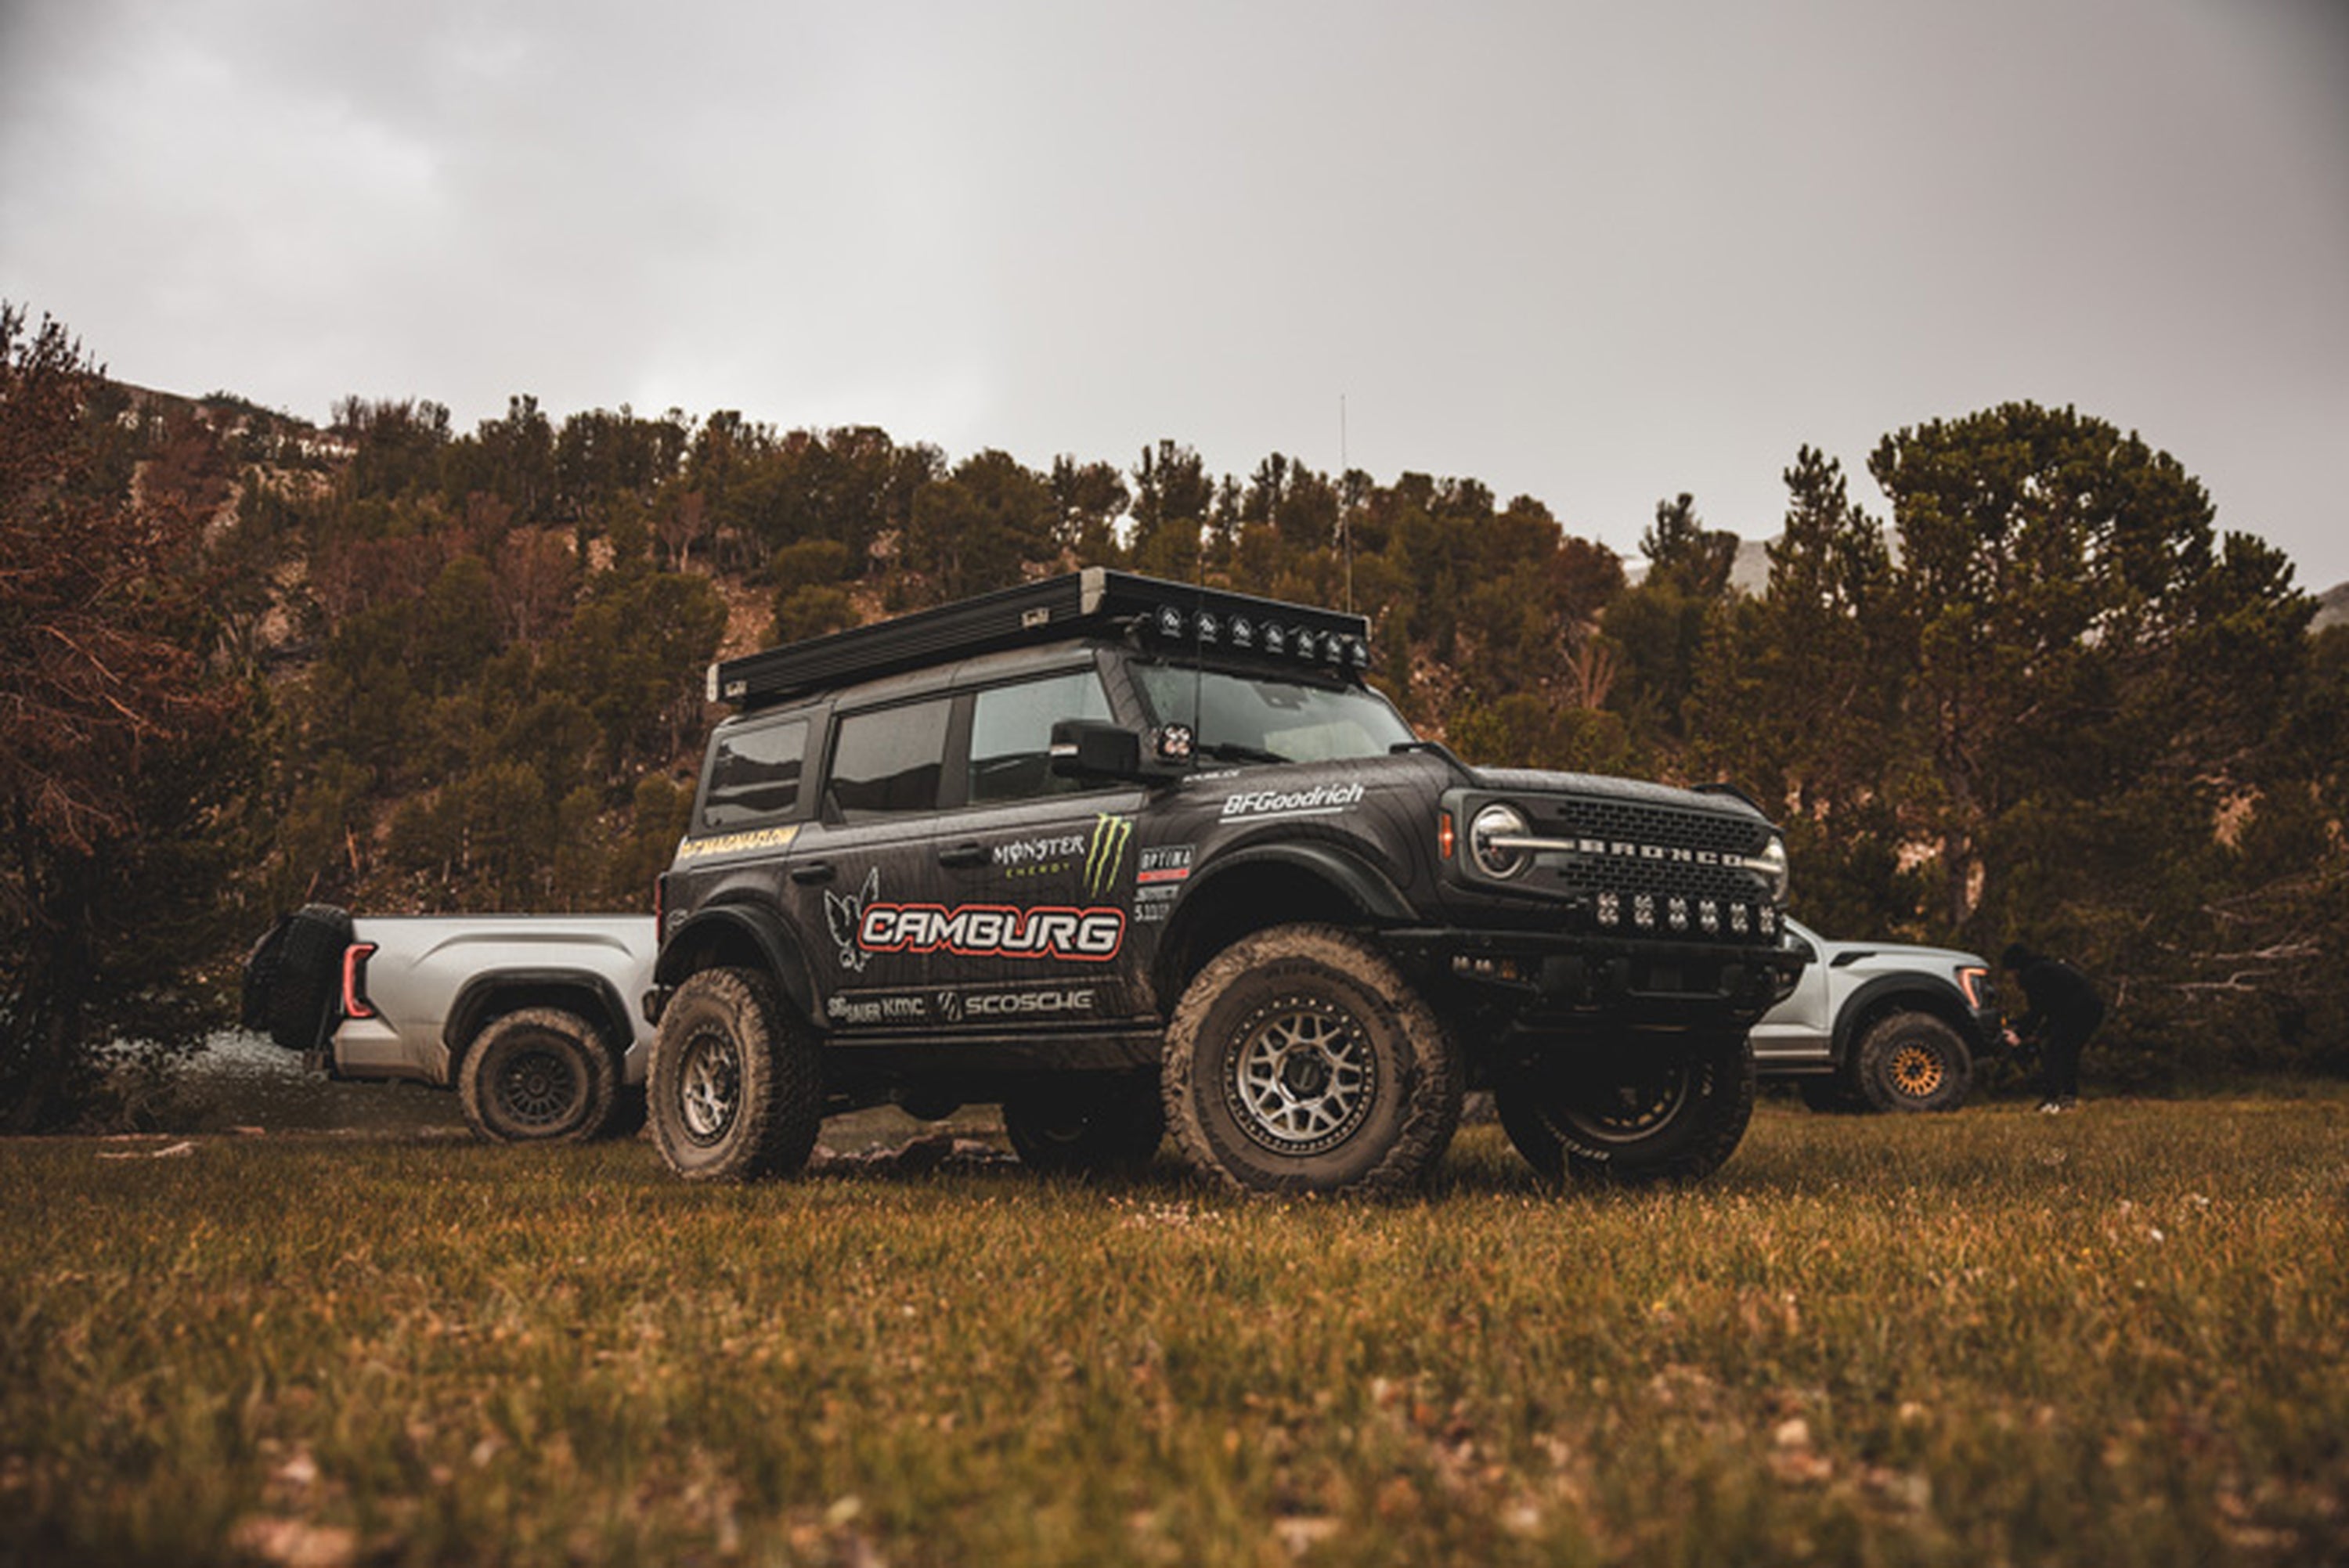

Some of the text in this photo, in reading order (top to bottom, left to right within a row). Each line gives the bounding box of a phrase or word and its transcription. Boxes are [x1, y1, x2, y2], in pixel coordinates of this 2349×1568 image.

[1222, 783, 1365, 815] BFGoodrich
[992, 834, 1085, 865] MONSTER
[1579, 838, 1742, 867] BRONCO
[863, 911, 1120, 952] CAMBURG
[965, 989, 1095, 1015] SCOSCHE
